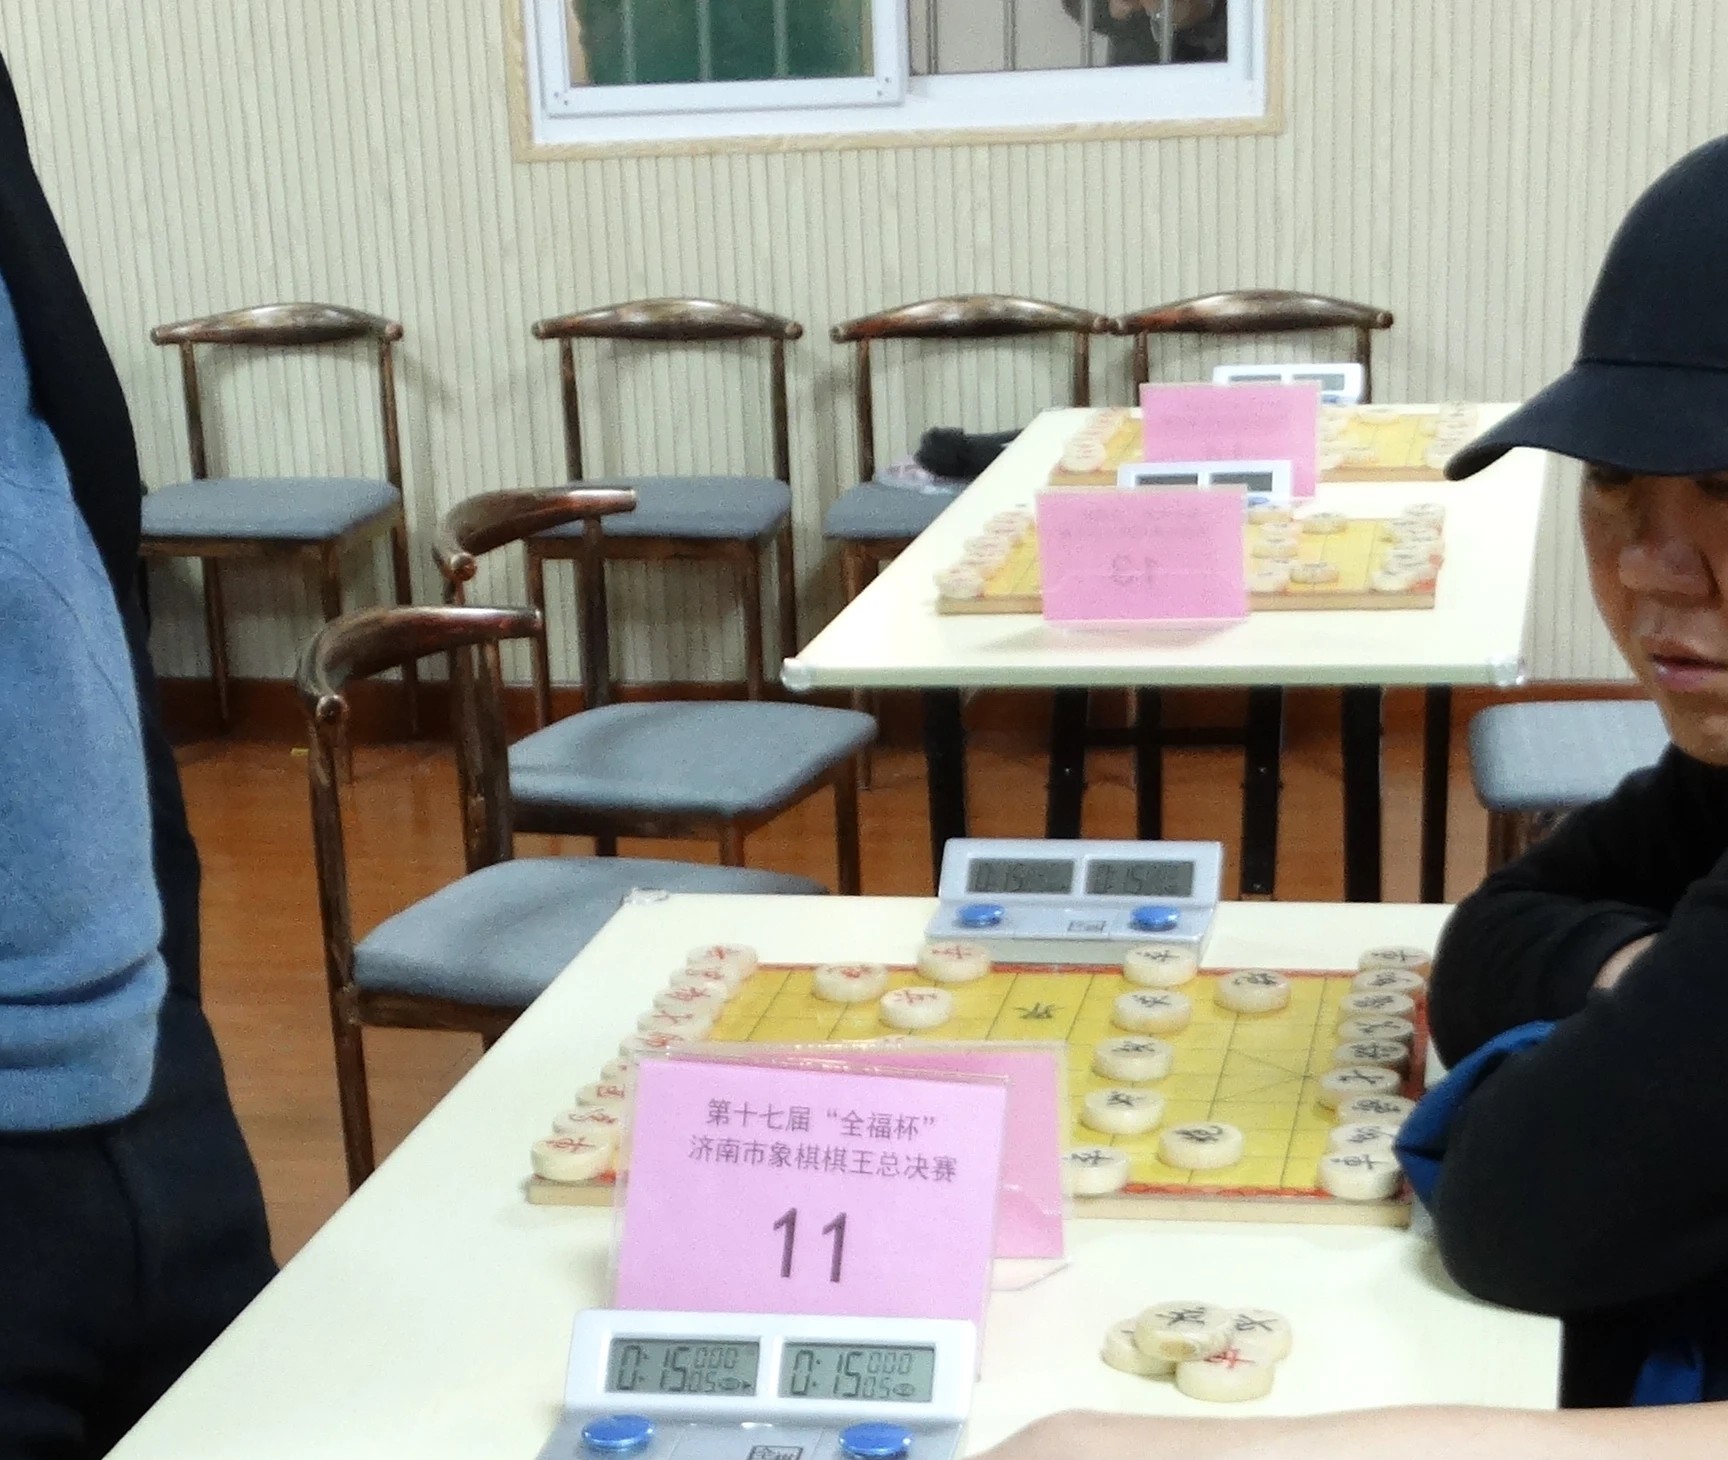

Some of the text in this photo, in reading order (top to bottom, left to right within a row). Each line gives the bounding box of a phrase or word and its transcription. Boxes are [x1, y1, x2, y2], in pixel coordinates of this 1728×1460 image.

[688, 1134, 958, 1184] 济南市象棋棋王总决赛
[772, 1206, 847, 1284] 11
